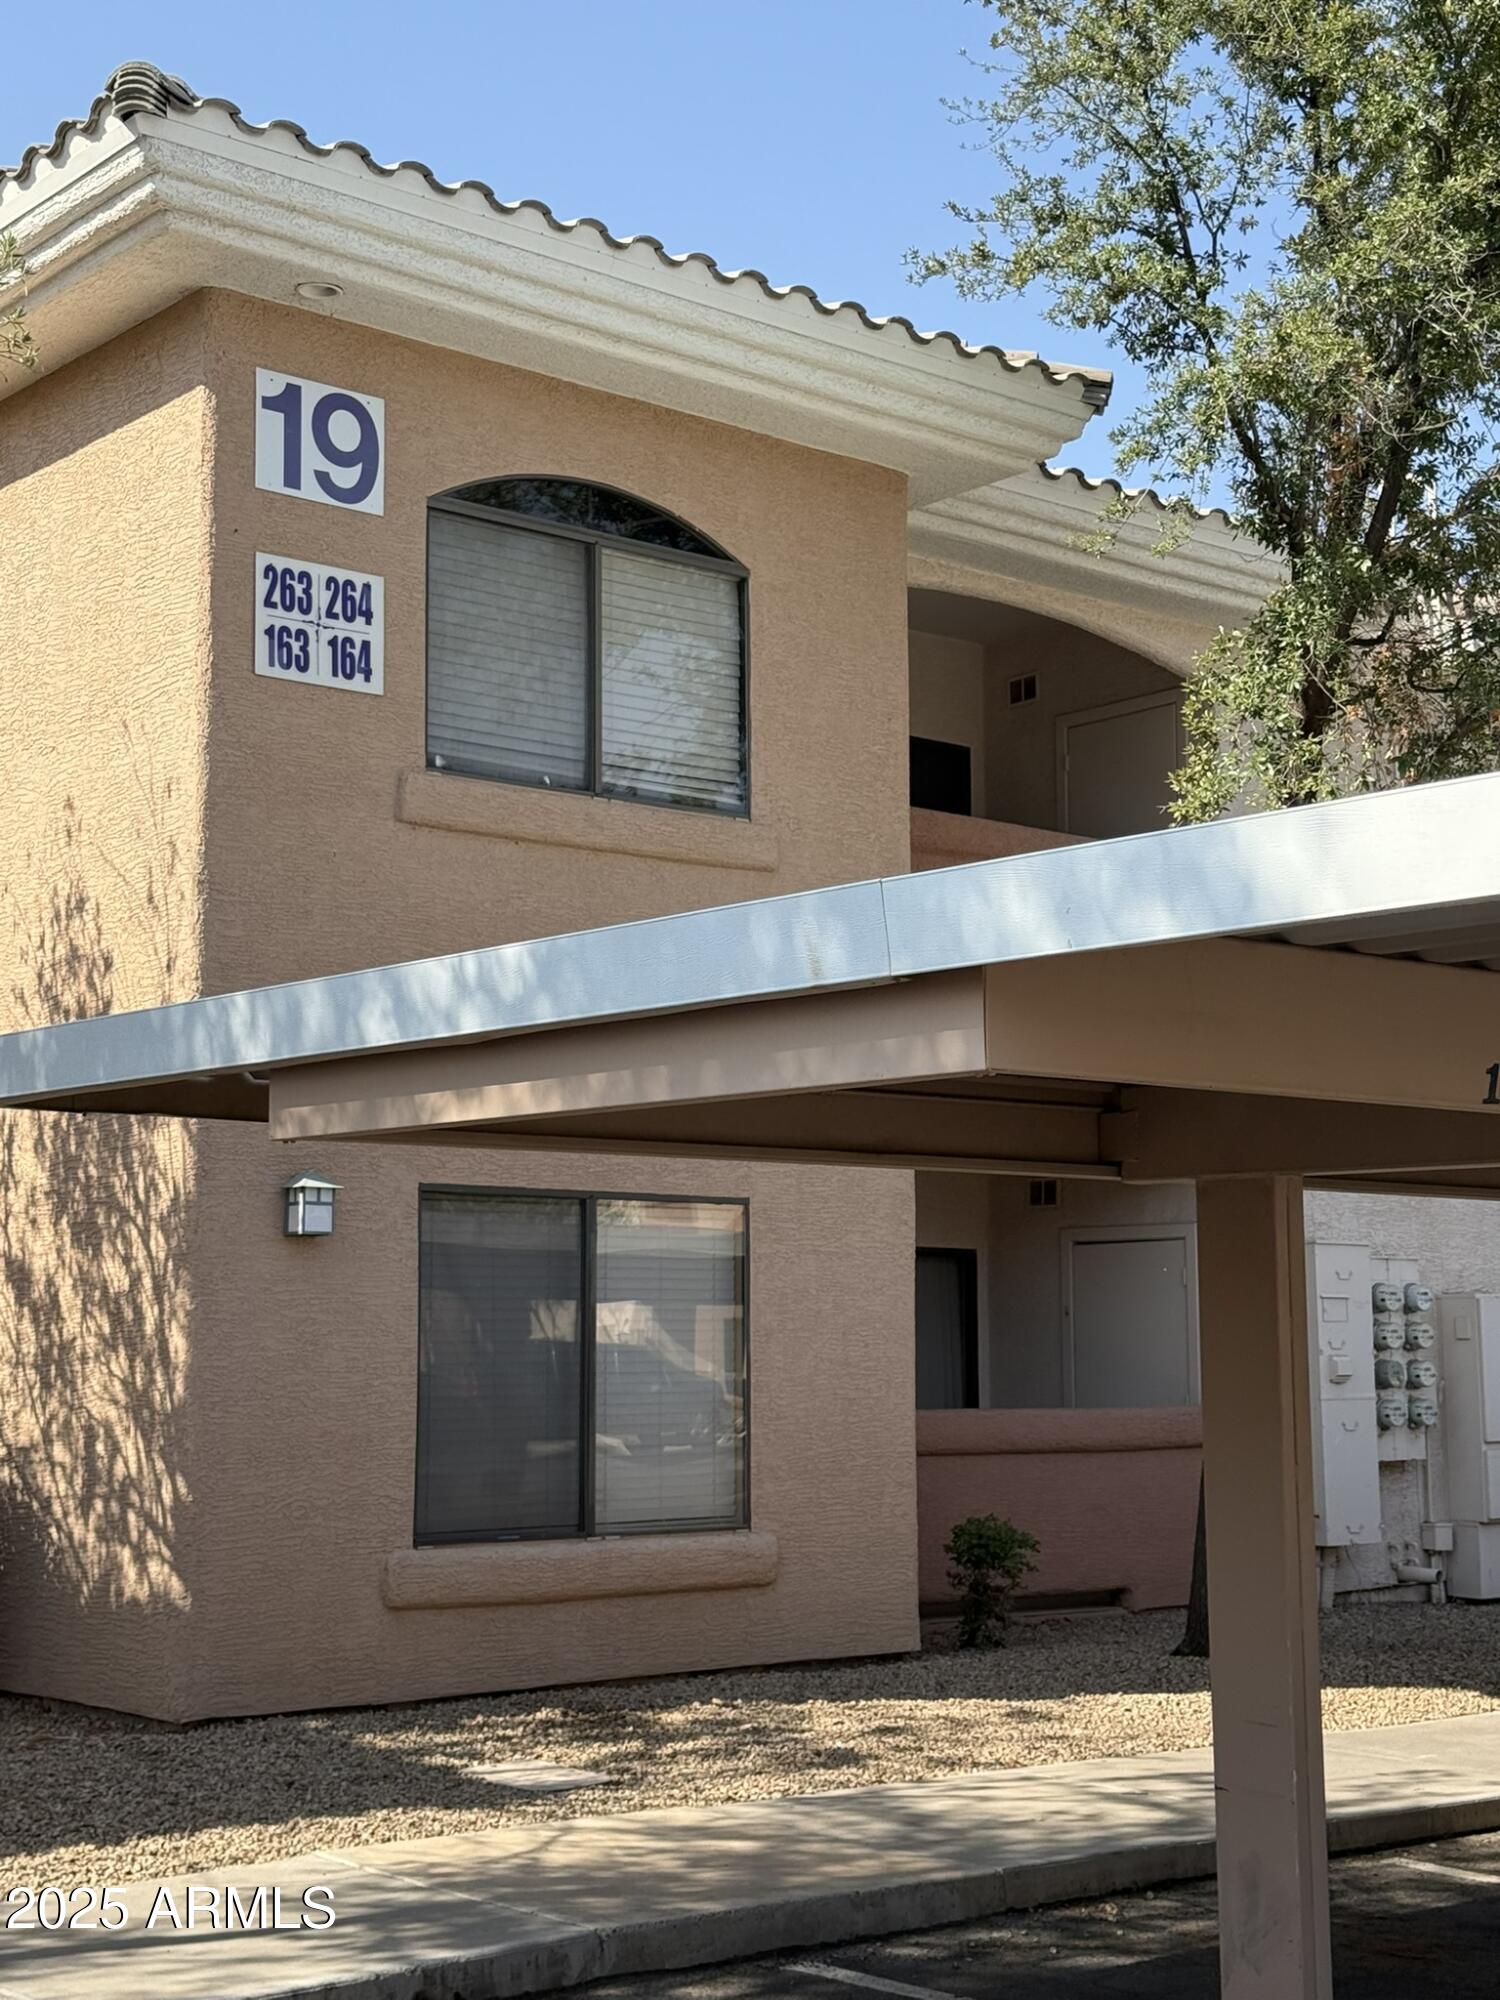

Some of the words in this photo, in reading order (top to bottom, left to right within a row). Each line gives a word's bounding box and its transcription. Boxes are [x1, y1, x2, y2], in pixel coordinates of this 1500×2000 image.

[261, 382, 379, 504] 19
[263, 563, 313, 615] 263
[325, 576, 373, 625] 264
[264, 624, 310, 673] 163
[327, 635, 373, 683] 164
